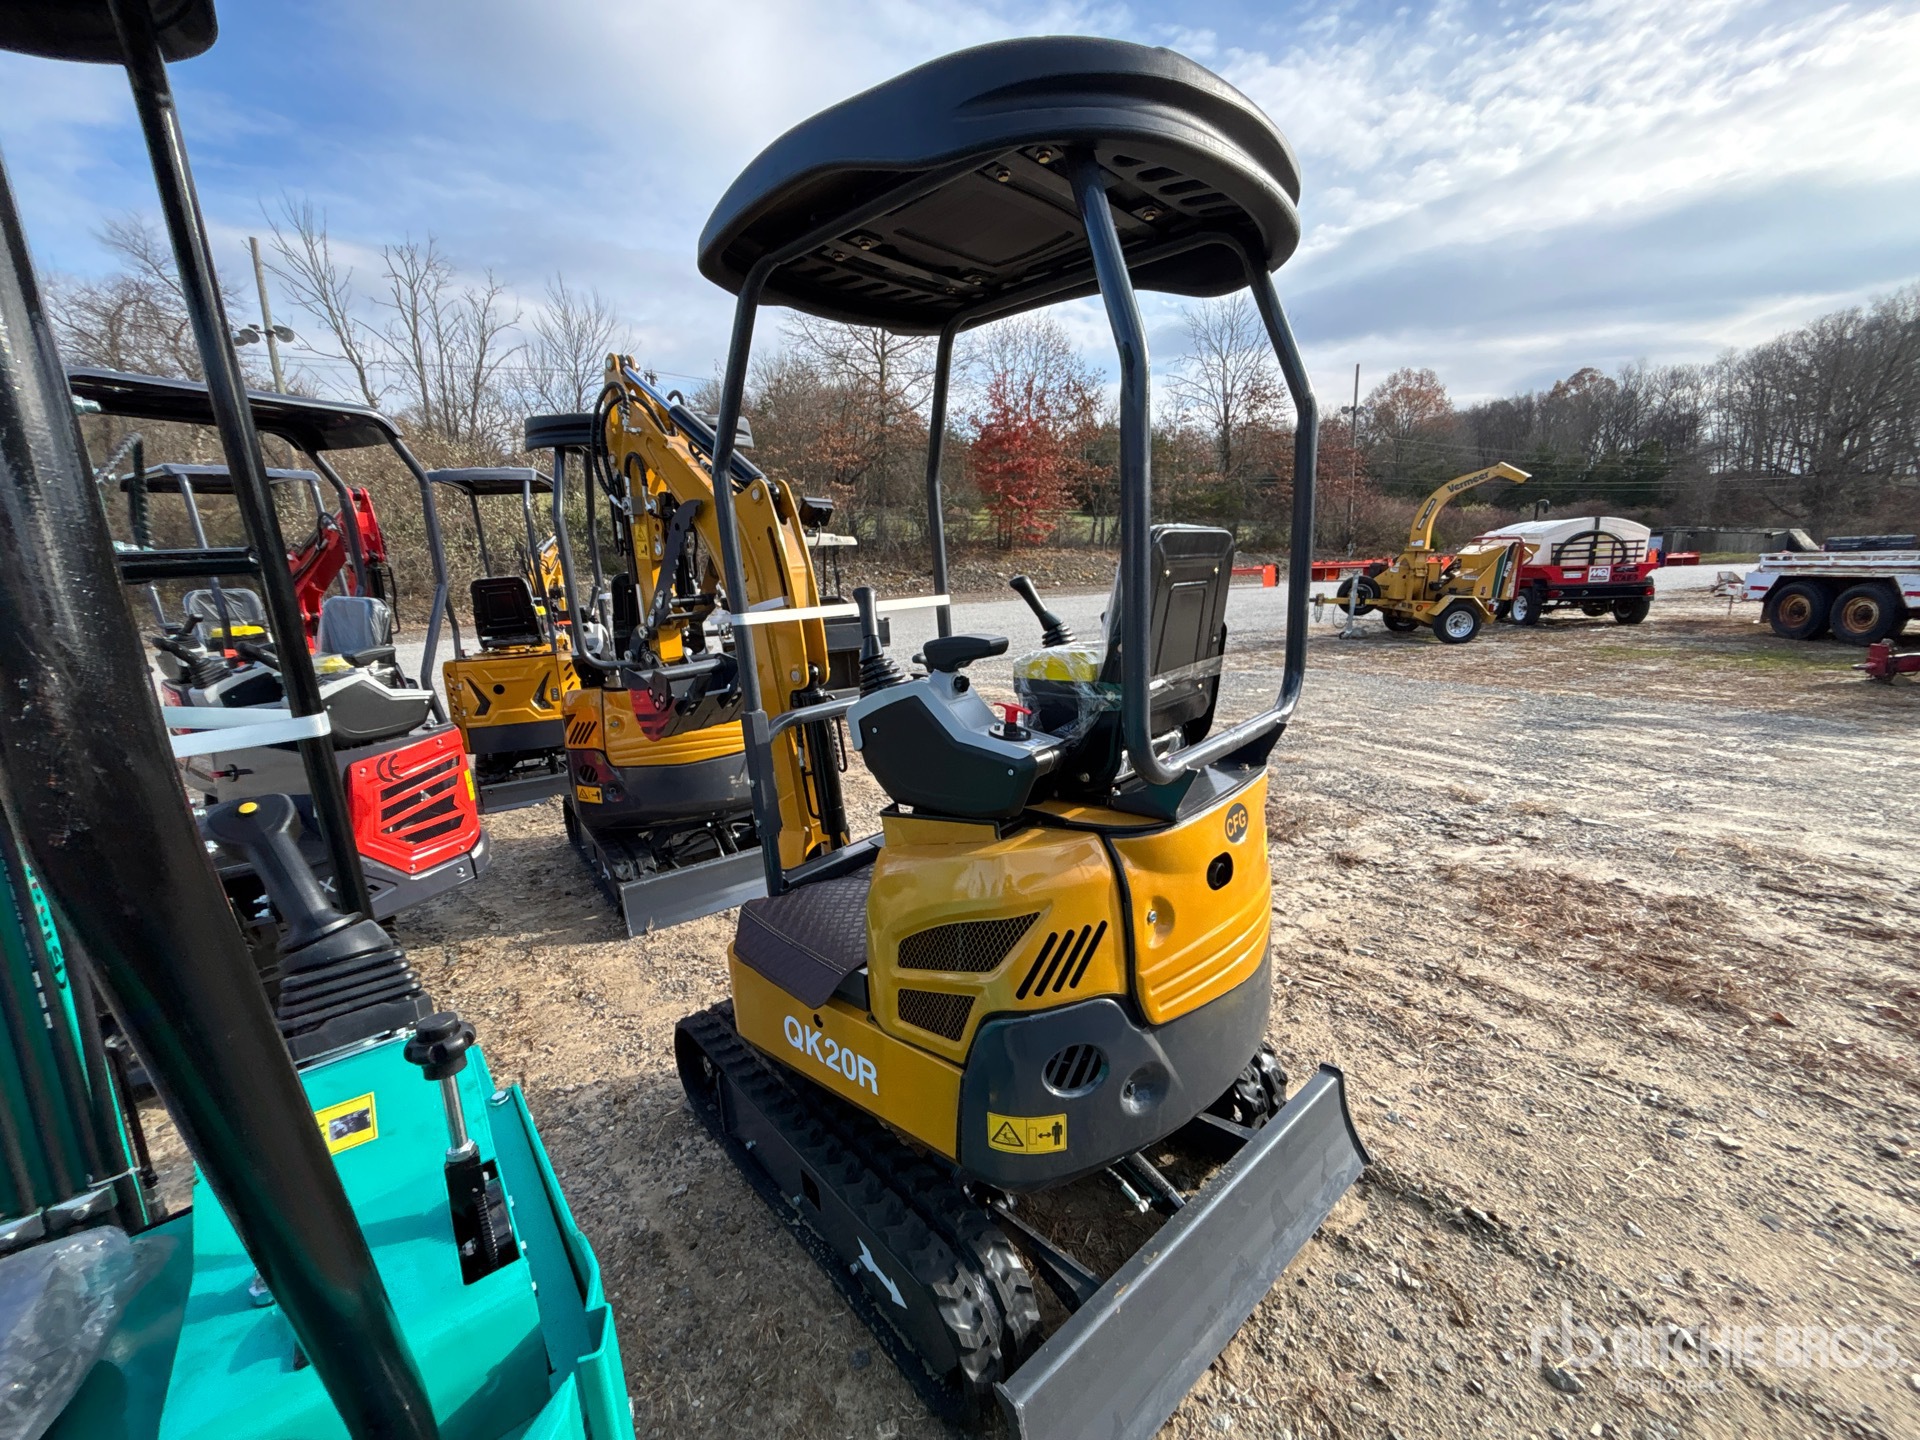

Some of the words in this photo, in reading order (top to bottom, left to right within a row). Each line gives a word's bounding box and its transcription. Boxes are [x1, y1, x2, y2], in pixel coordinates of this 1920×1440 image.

[1447, 472, 1489, 493] Vermeer
[1227, 809, 1246, 837] CFG
[784, 1015, 879, 1096] QK20R
